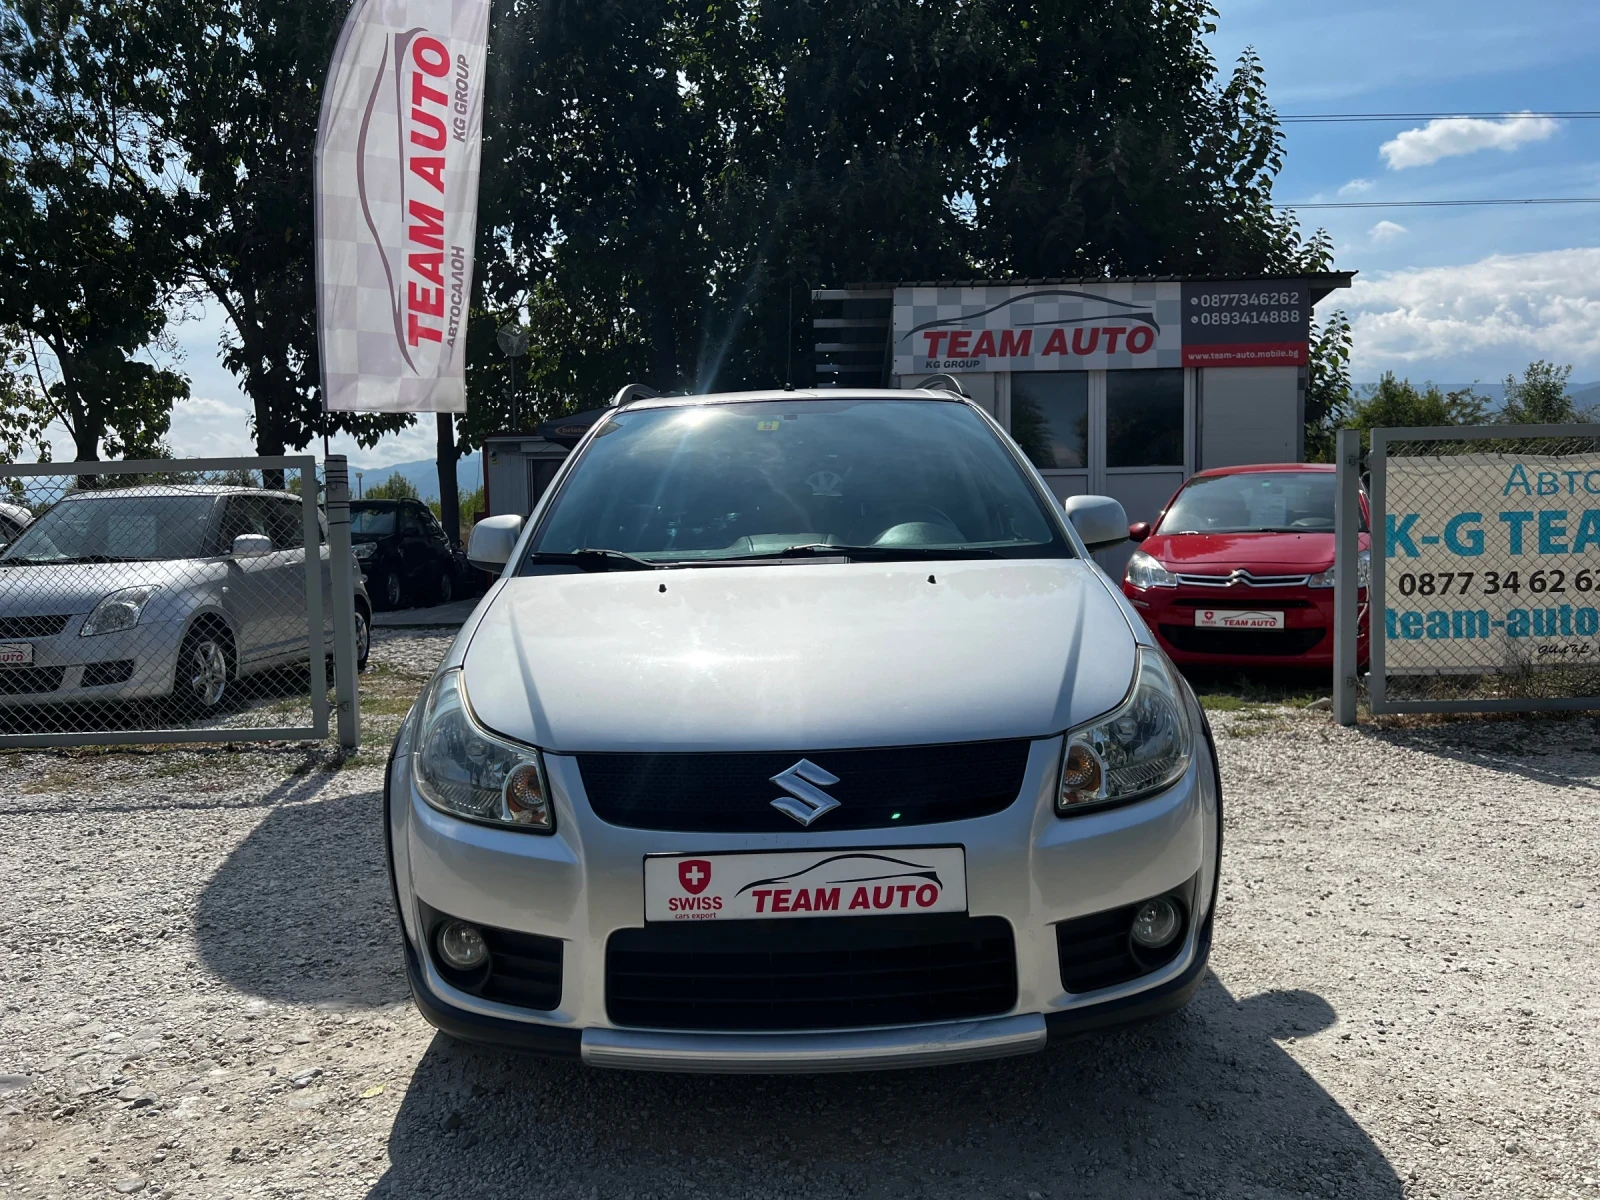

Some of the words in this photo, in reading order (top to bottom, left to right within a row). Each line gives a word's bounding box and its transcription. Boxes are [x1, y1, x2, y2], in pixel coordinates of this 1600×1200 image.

[454, 54, 469, 115] GROUP
[409, 36, 450, 195] AUTO
[453, 117, 466, 142] KG
[408, 199, 444, 347] TEAM
[447, 246, 465, 348] АВТОСАЛОН
[1201, 292, 1299, 307] 0877346262
[1201, 310, 1300, 325] 0893414888
[923, 330, 1033, 359] TEAM
[1041, 325, 1155, 356] AUTO
[1188, 350, 1299, 360] www.team-auto.mobile.bg
[925, 360, 942, 369] KG
[943, 360, 980, 369] GROUP
[1386, 512, 1485, 558] K-G
[1399, 572, 1474, 596] 0877
[1484, 571, 1520, 594] 34
[1529, 569, 1566, 593] 62
[1385, 604, 1599, 639] team-auto
[0, 654, 23, 662] UTO
[668, 896, 723, 912] SWISS
[752, 887, 841, 913] TEAM
[848, 883, 939, 910] AUTO
[692, 912, 717, 921] export
